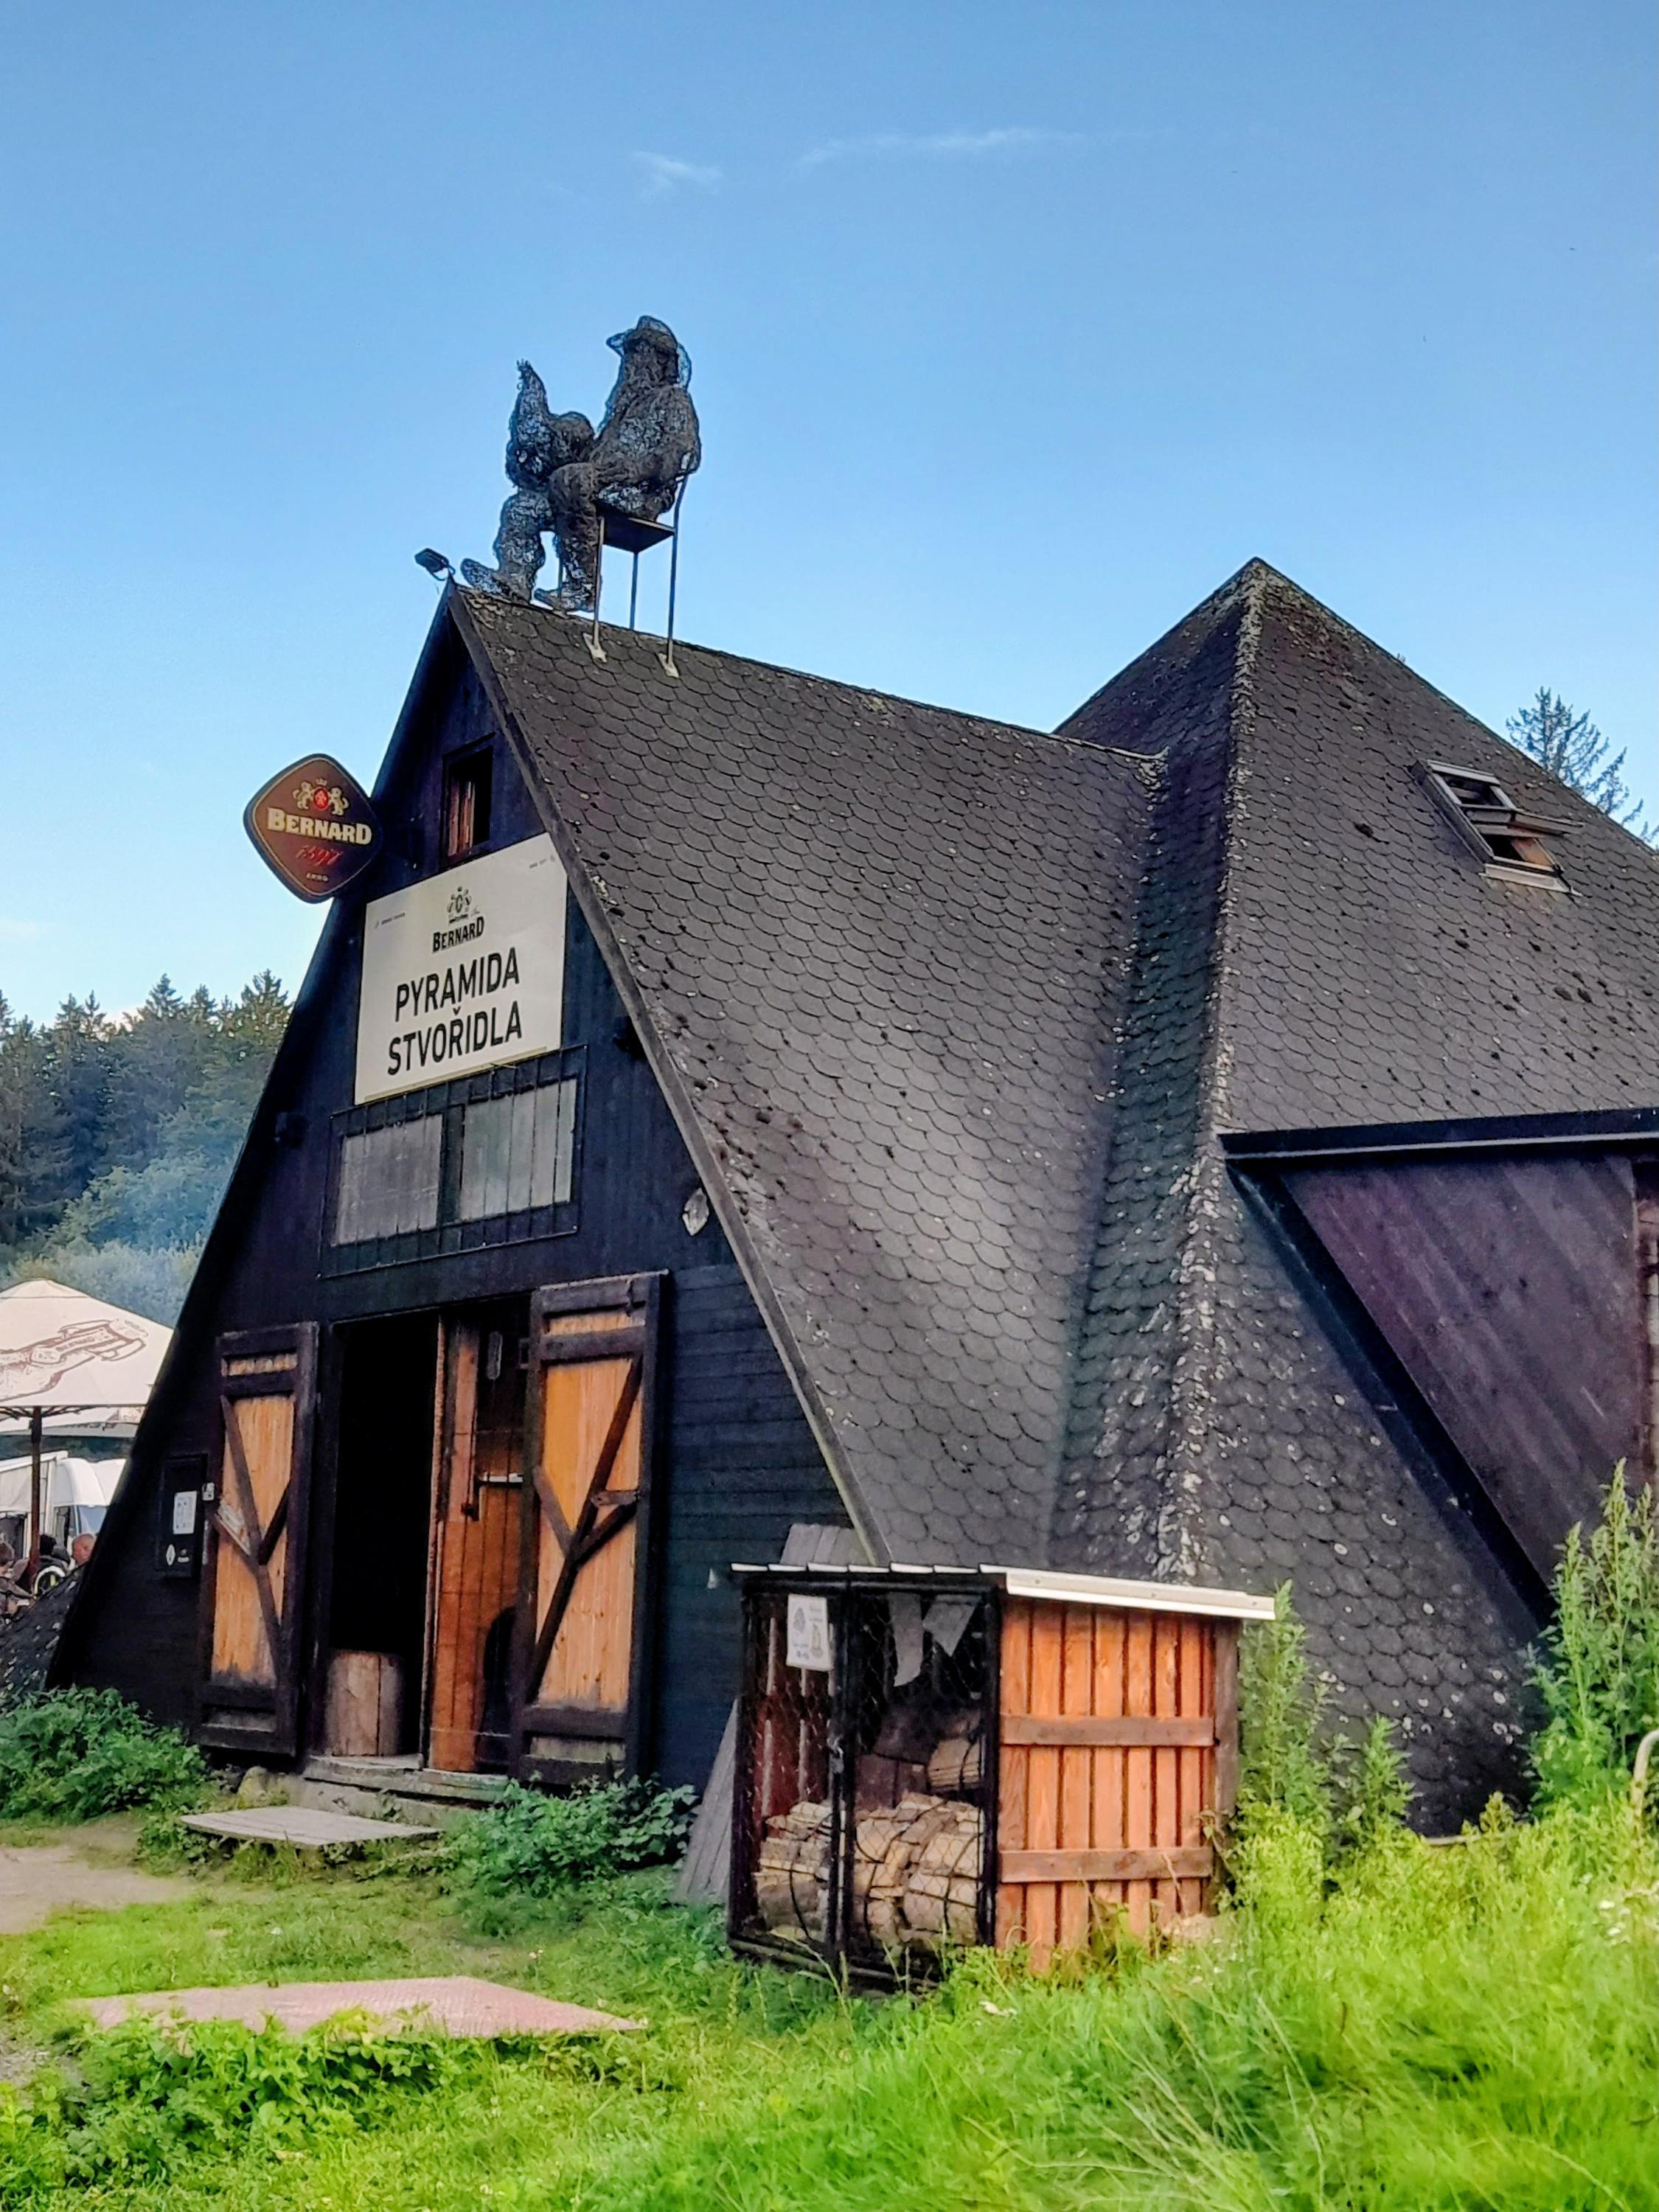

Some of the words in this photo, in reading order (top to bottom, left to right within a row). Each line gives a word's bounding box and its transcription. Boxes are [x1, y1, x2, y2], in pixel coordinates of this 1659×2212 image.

[267, 807, 372, 845] BERNARD
[433, 916, 484, 953] BERNARD
[395, 947, 520, 1022] PYRAMIDA
[387, 1001, 522, 1076] STVOŘIDLA
